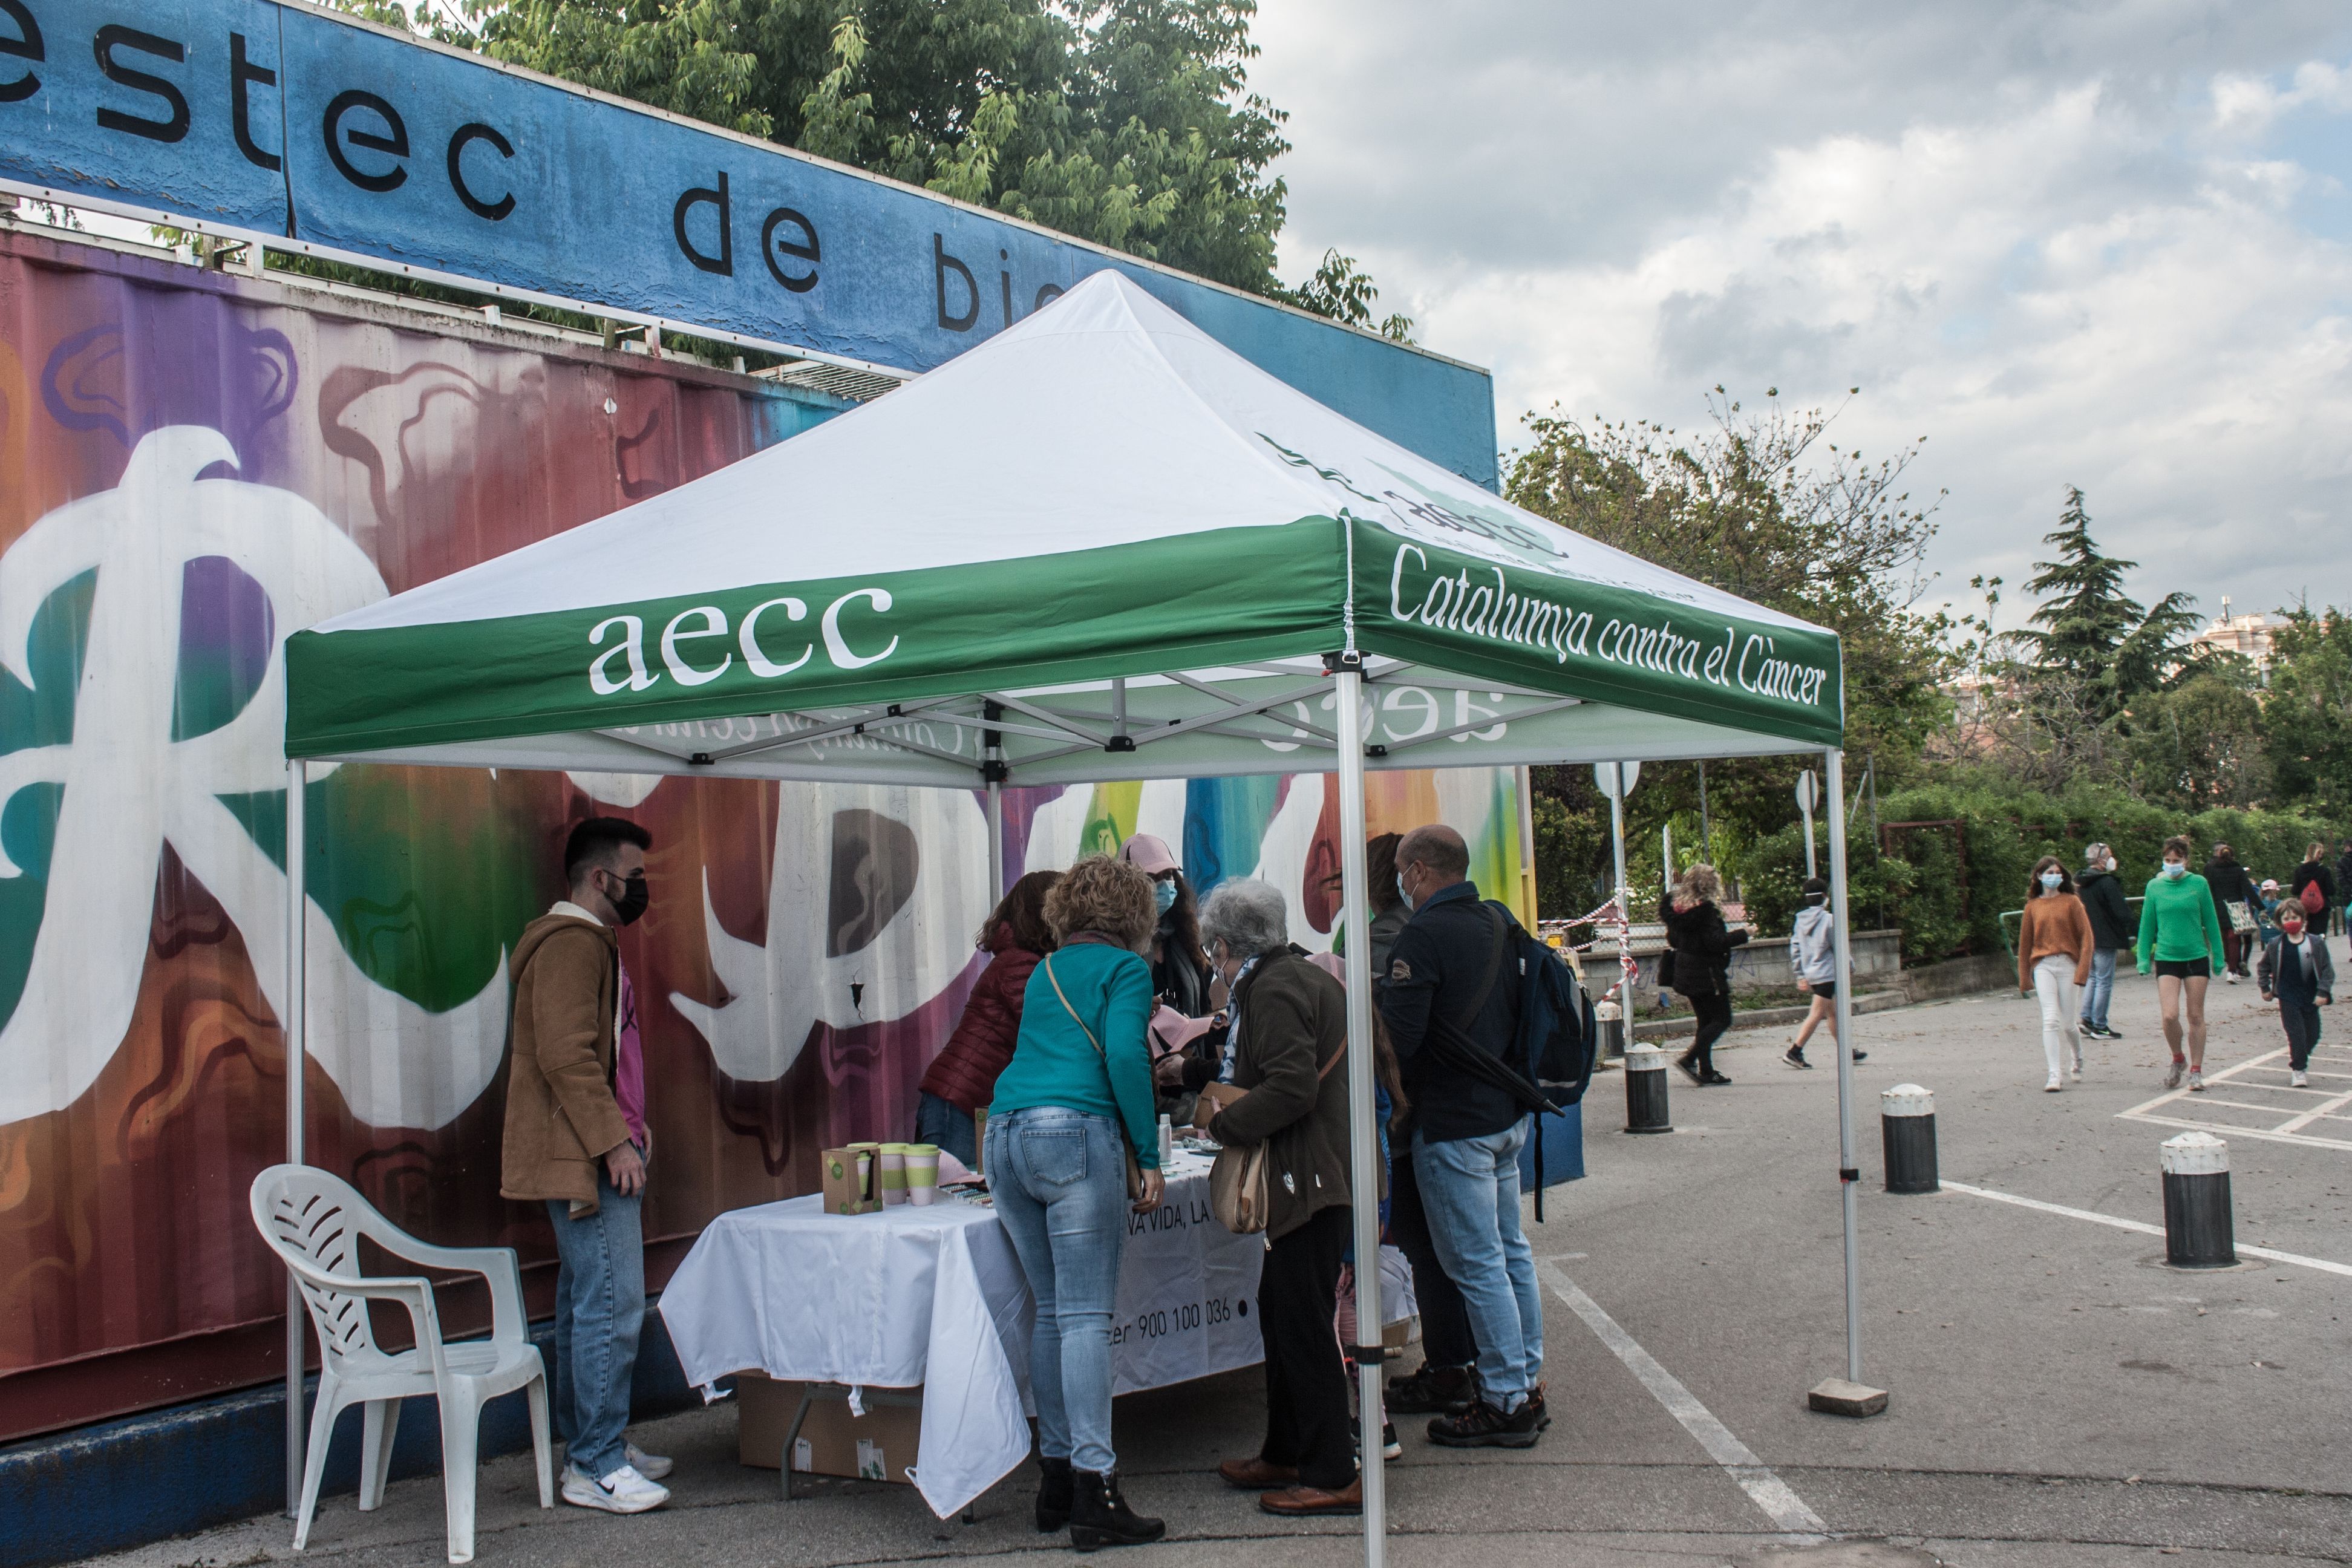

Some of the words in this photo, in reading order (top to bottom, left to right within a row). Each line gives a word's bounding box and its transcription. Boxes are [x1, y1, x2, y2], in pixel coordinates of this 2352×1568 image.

[673, 171, 821, 293] de
[588, 587, 899, 695] aecc
[1390, 543, 1593, 664] Catalunya
[1597, 621, 1700, 681] contra
[1704, 627, 1735, 687] el
[1737, 633, 1826, 706] Càncer
[1149, 1204, 1186, 1232] VIDA,
[1191, 1199, 1210, 1225] LA
[1109, 1324, 1131, 1347] er
[1138, 1310, 1168, 1340] 900
[1172, 1303, 1200, 1332] 100
[1206, 1296, 1231, 1325] 036
